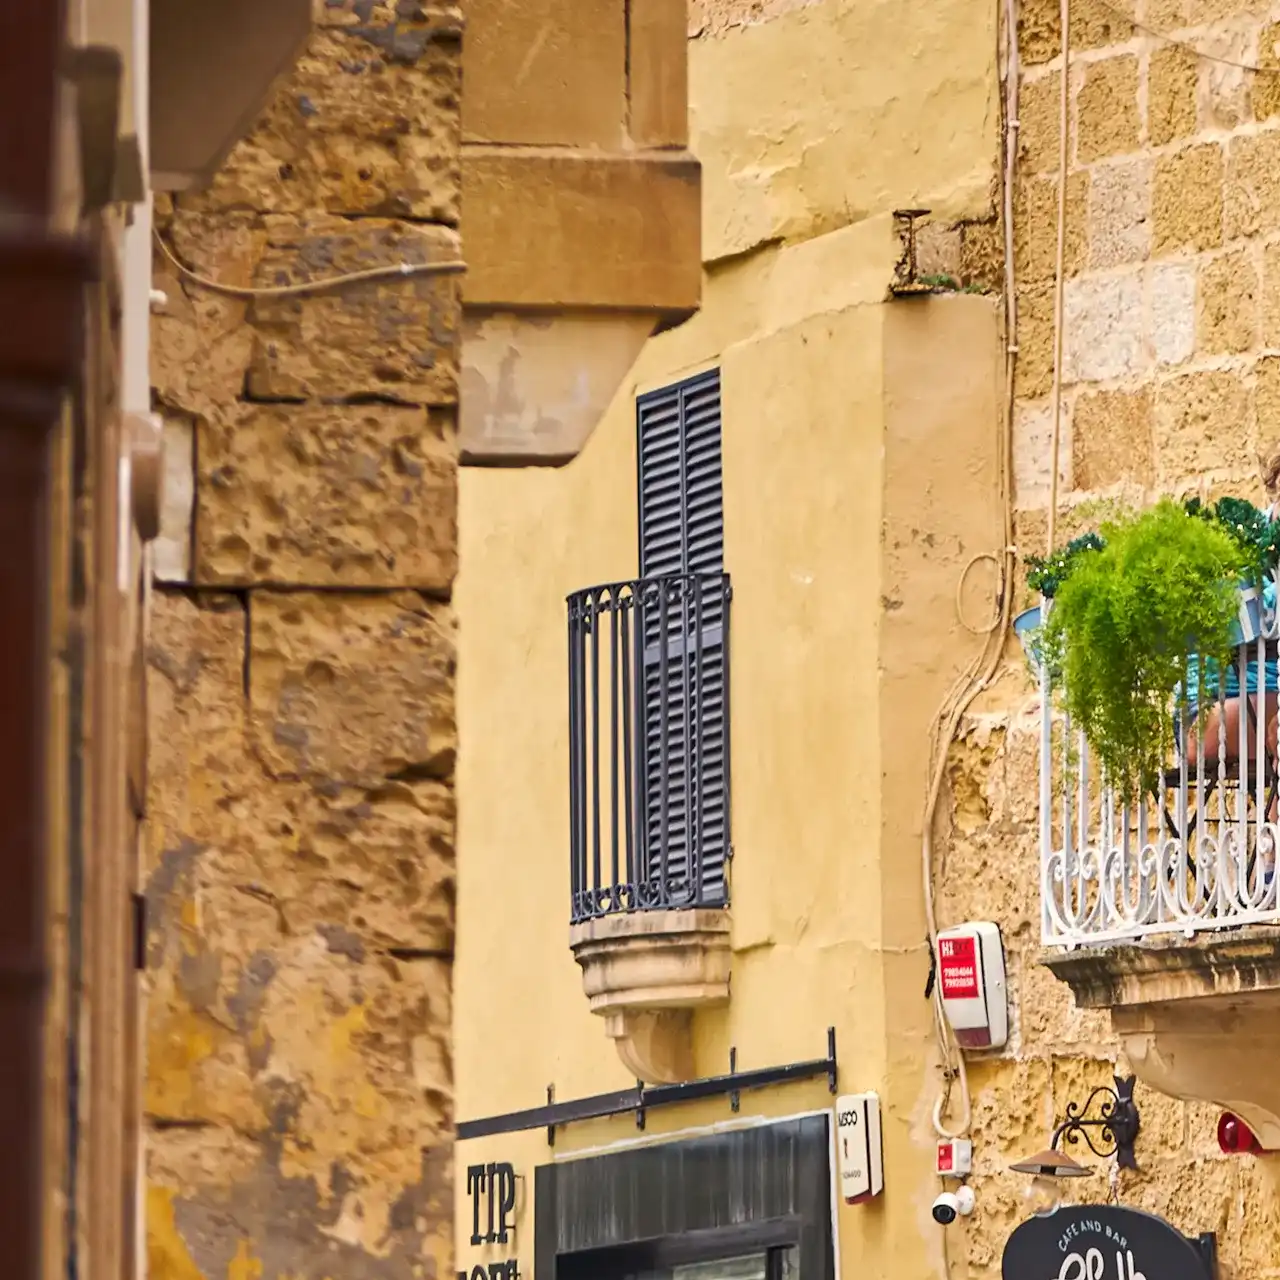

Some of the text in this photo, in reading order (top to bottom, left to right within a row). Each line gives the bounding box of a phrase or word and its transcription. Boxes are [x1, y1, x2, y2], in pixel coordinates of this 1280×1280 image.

[467, 1162, 515, 1246] TIP
[1058, 1219, 1129, 1252] CAFE AND BAR
